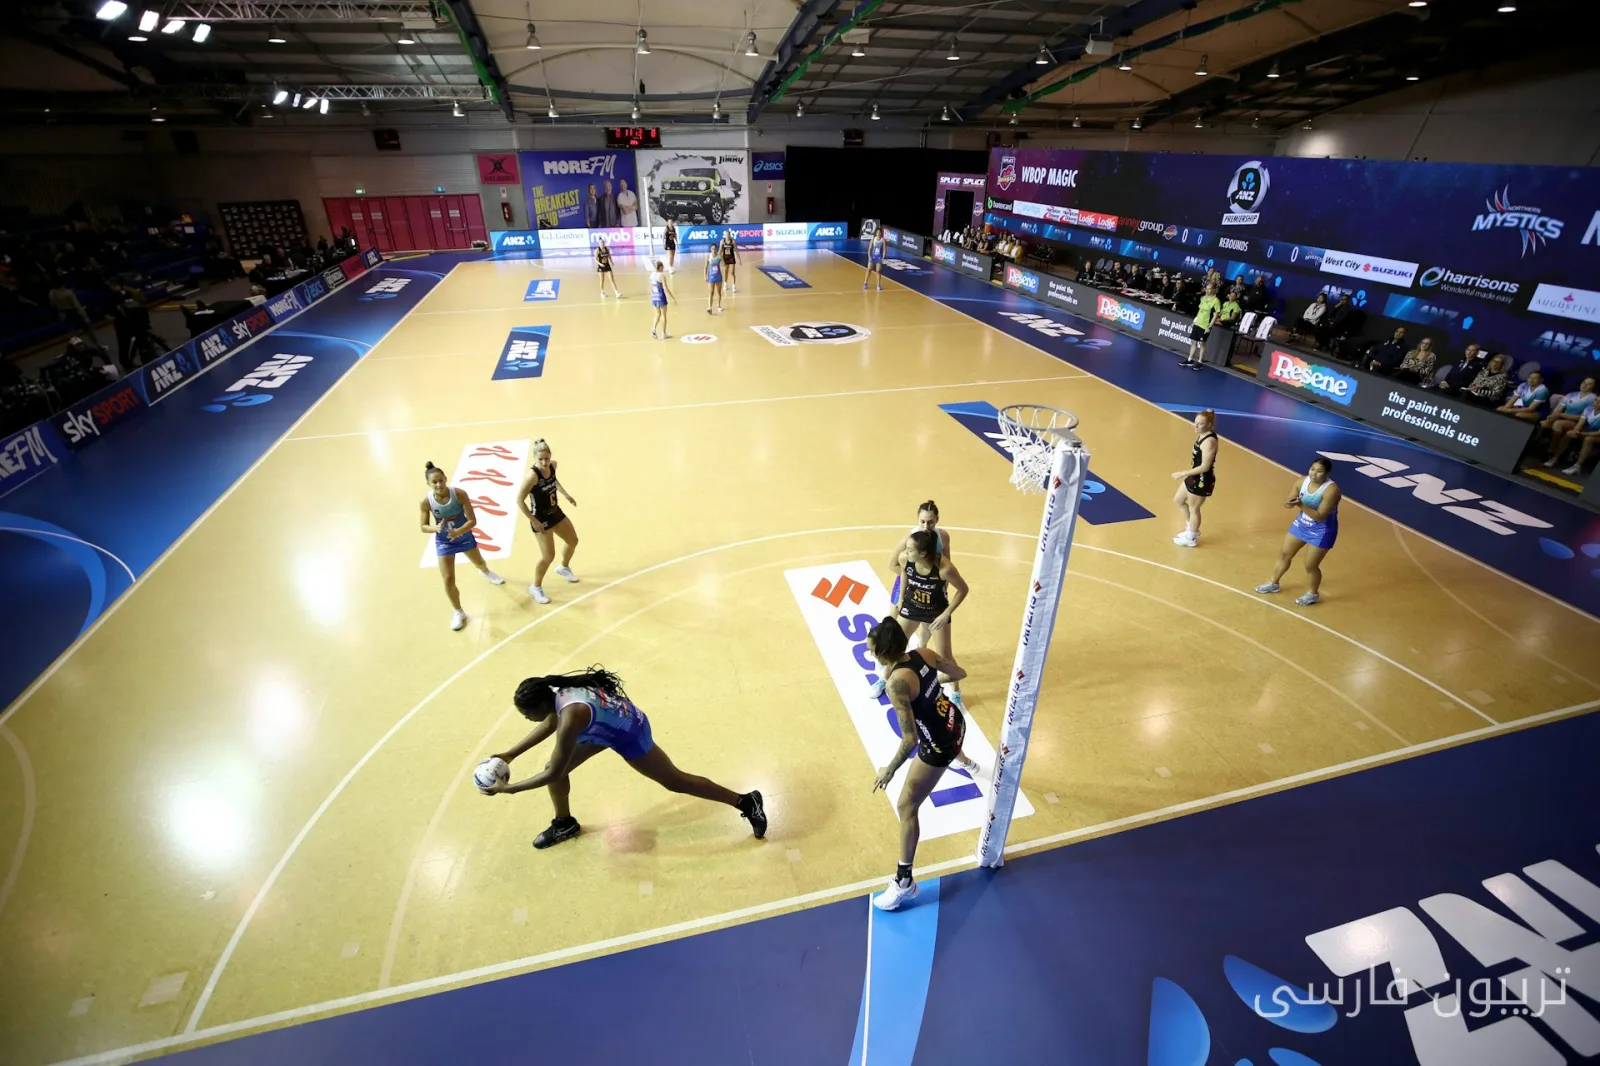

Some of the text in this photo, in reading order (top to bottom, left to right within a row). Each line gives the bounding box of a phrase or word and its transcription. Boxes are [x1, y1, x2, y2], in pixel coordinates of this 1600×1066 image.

[543, 154, 617, 180] MOREFM
[763, 162, 783, 171] asics
[1021, 166, 1079, 188] WBOP MAGIC
[532, 185, 544, 198] THE
[940, 176, 985, 186] SPLICE SPLICE
[534, 189, 580, 214] BREAKFAST
[1235, 190, 1255, 201] ANZ
[1224, 214, 1258, 224] PREMIERSHIP
[1507, 205, 1542, 214] NORTHERN
[688, 230, 709, 240] ANZ
[739, 229, 764, 238] SPORT
[775, 228, 807, 236] SUZUKI
[815, 227, 835, 237] ANZ
[1471, 212, 1565, 239] MYSTICS
[503, 236, 526, 246] ANZ
[590, 231, 632, 247] myob
[1218, 237, 1250, 252] REBOUNDS
[1291, 246, 1299, 263] 0
[1009, 268, 1037, 289] Resene
[1325, 256, 1413, 279] West City SUZUKI
[1443, 269, 1520, 294] harrisons
[1440, 283, 1514, 305] Wonderful made easy
[1099, 296, 1141, 325] Resene
[1535, 298, 1598, 317] AUGUSTINE
[232, 319, 252, 341] sky
[997, 311, 1086, 337] ANZ
[1161, 316, 1171, 327] the
[1171, 321, 1188, 332] paint
[200, 333, 228, 362] ANZ
[1531, 330, 1594, 358] ANZ
[151, 359, 184, 393] ANZ
[225, 353, 314, 393] ANZ
[1274, 355, 1349, 398] Resene
[63, 386, 140, 443] sky SPORT
[1388, 391, 1461, 424] the paint the
[1382, 406, 1480, 447] professionals use
[1315, 450, 1554, 536] ANZ
[907, 578, 937, 590] SPLICE
